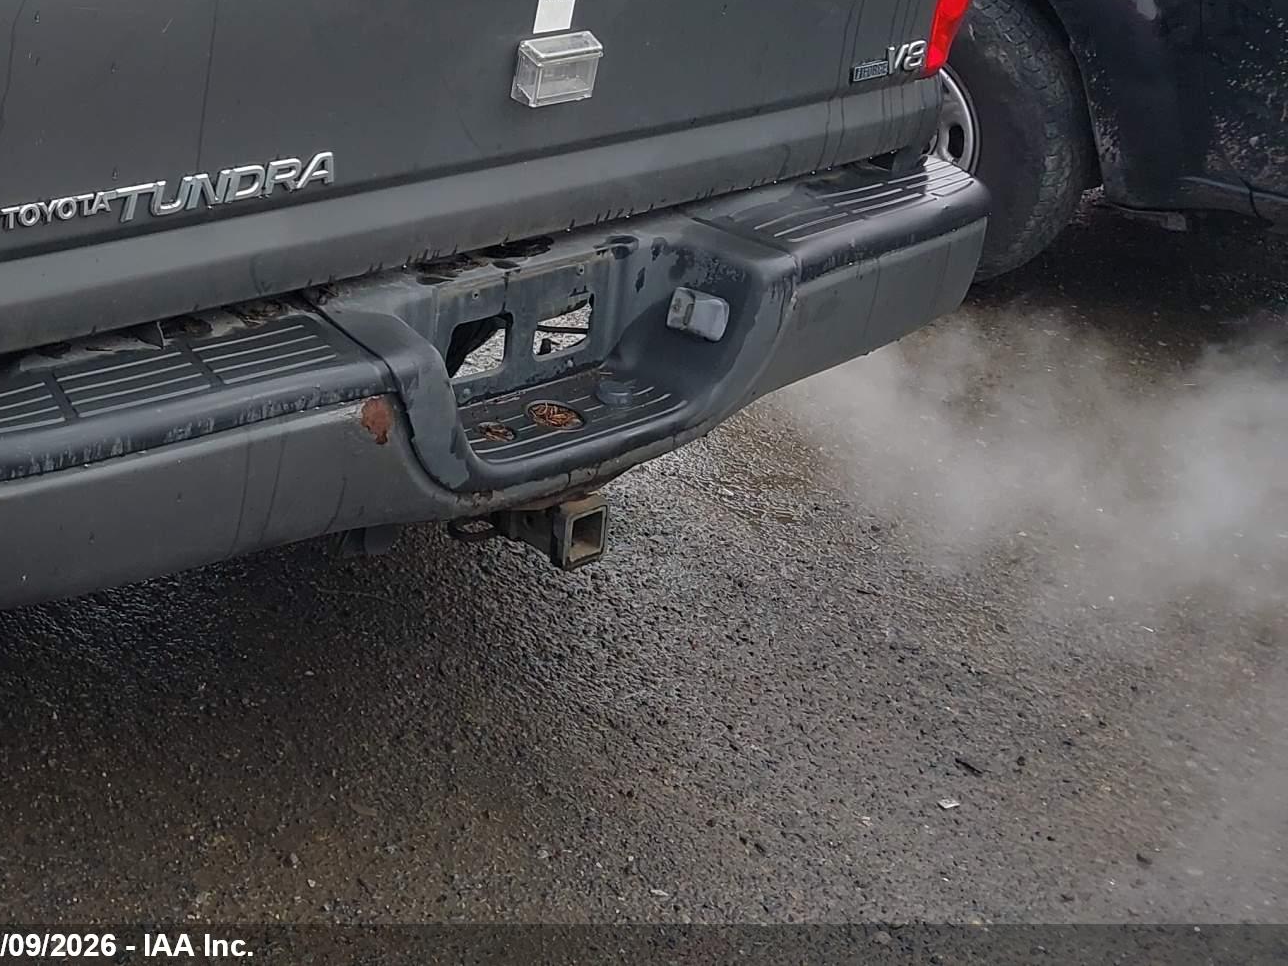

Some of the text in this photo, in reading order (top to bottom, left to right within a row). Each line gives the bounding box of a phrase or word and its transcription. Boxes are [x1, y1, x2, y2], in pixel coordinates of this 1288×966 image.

[887, 40, 927, 75] V8
[0, 151, 334, 230] TOYOTA TUNDRA
